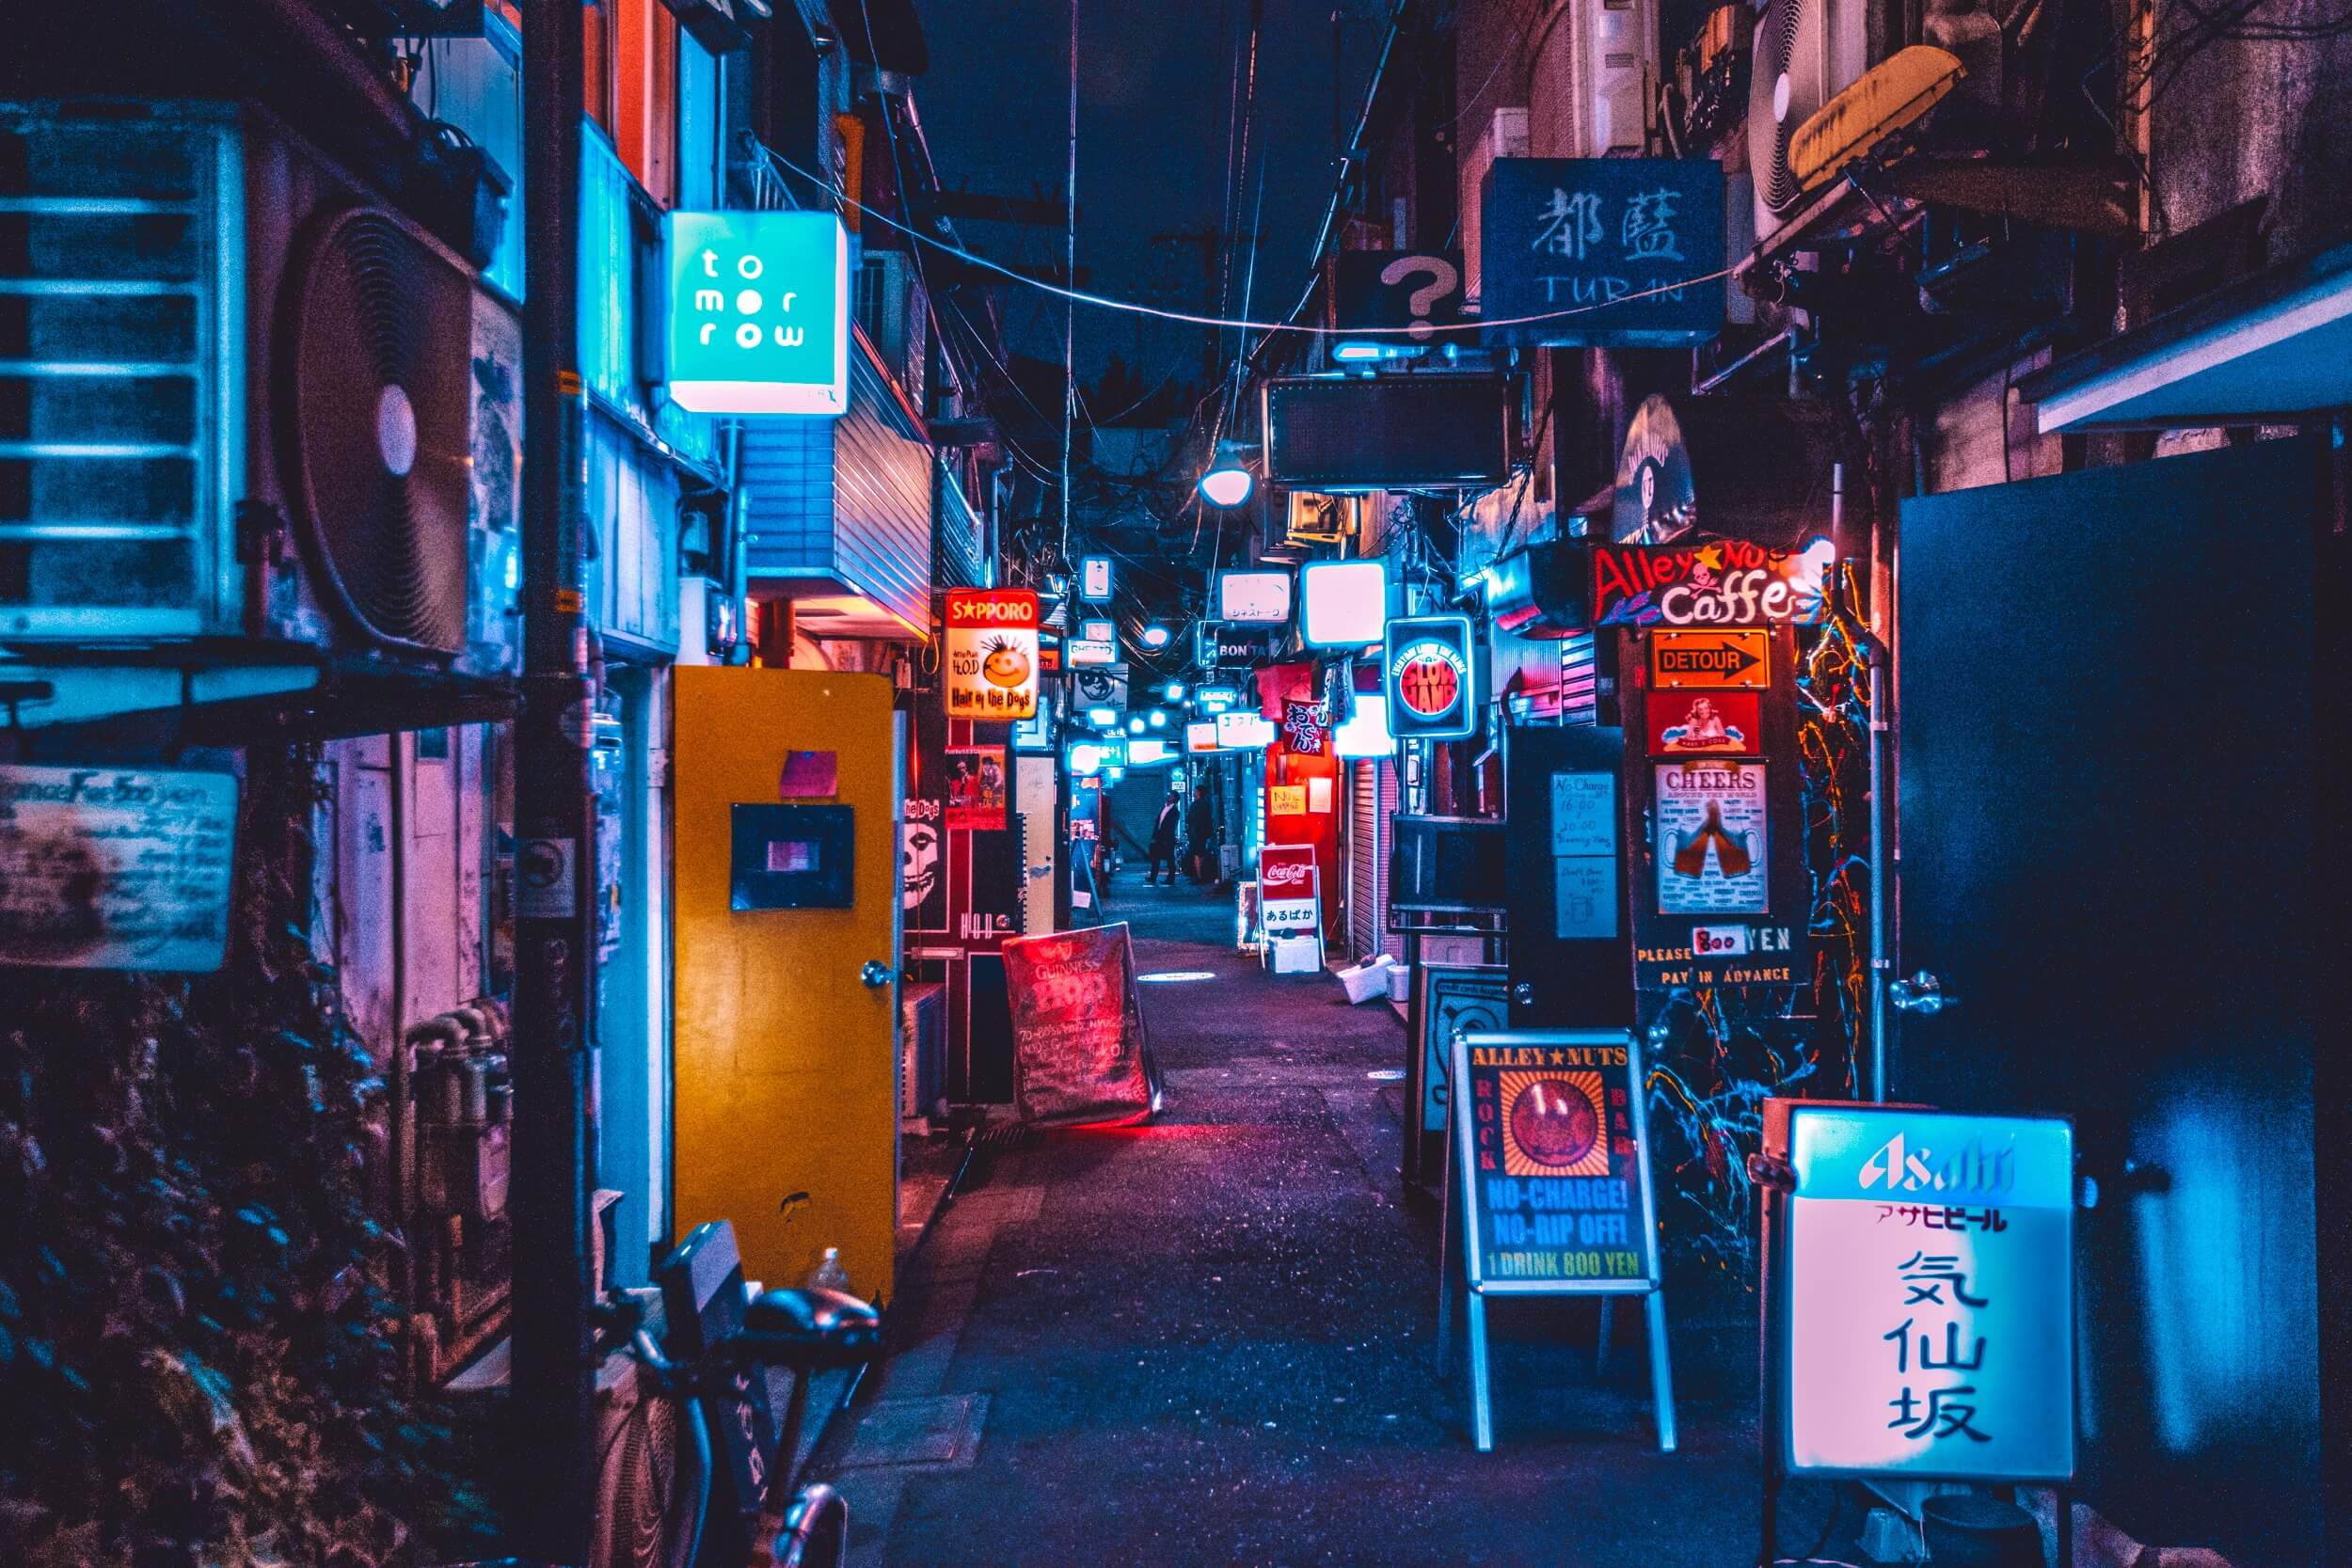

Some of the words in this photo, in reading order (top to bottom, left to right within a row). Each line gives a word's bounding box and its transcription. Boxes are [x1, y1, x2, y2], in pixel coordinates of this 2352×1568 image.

[702, 248, 763, 280] to
[699, 322, 804, 350] row
[1594, 547, 1692, 623] Alley
[1219, 644, 1267, 657] BONTA
[1662, 651, 1740, 670] DETOUR
[952, 688, 973, 707] Hair
[988, 689, 1004, 705] the
[1007, 690, 1030, 711] Dogs
[1289, 703, 1316, 752] おでん
[1666, 772, 1756, 789] CHEERS
[918, 804, 939, 819] Dogs
[1638, 948, 1693, 962] PLEASE
[1748, 927, 1791, 951] YEN
[1661, 971, 1689, 985] PAY
[1699, 971, 1713, 984] IN
[1724, 968, 1791, 984] ADVANCE
[1471, 1047, 1547, 1067] ALLEY
[1567, 1047, 1627, 1066] NUTS
[1476, 1080, 1497, 1170] ROCK
[1611, 1088, 1631, 1155] BAR
[1486, 1180, 1629, 1210] NO-CHARGE!
[1493, 1214, 1573, 1244] NO-RIP
[1579, 1214, 1627, 1244] OFF!
[1874, 1205, 2008, 1232] アサヒビール
[1501, 1253, 1559, 1276] DRINK
[1564, 1253, 1601, 1275] 800
[1605, 1252, 1639, 1275] YEN
[1883, 1250, 1993, 1444] 気仙坂
